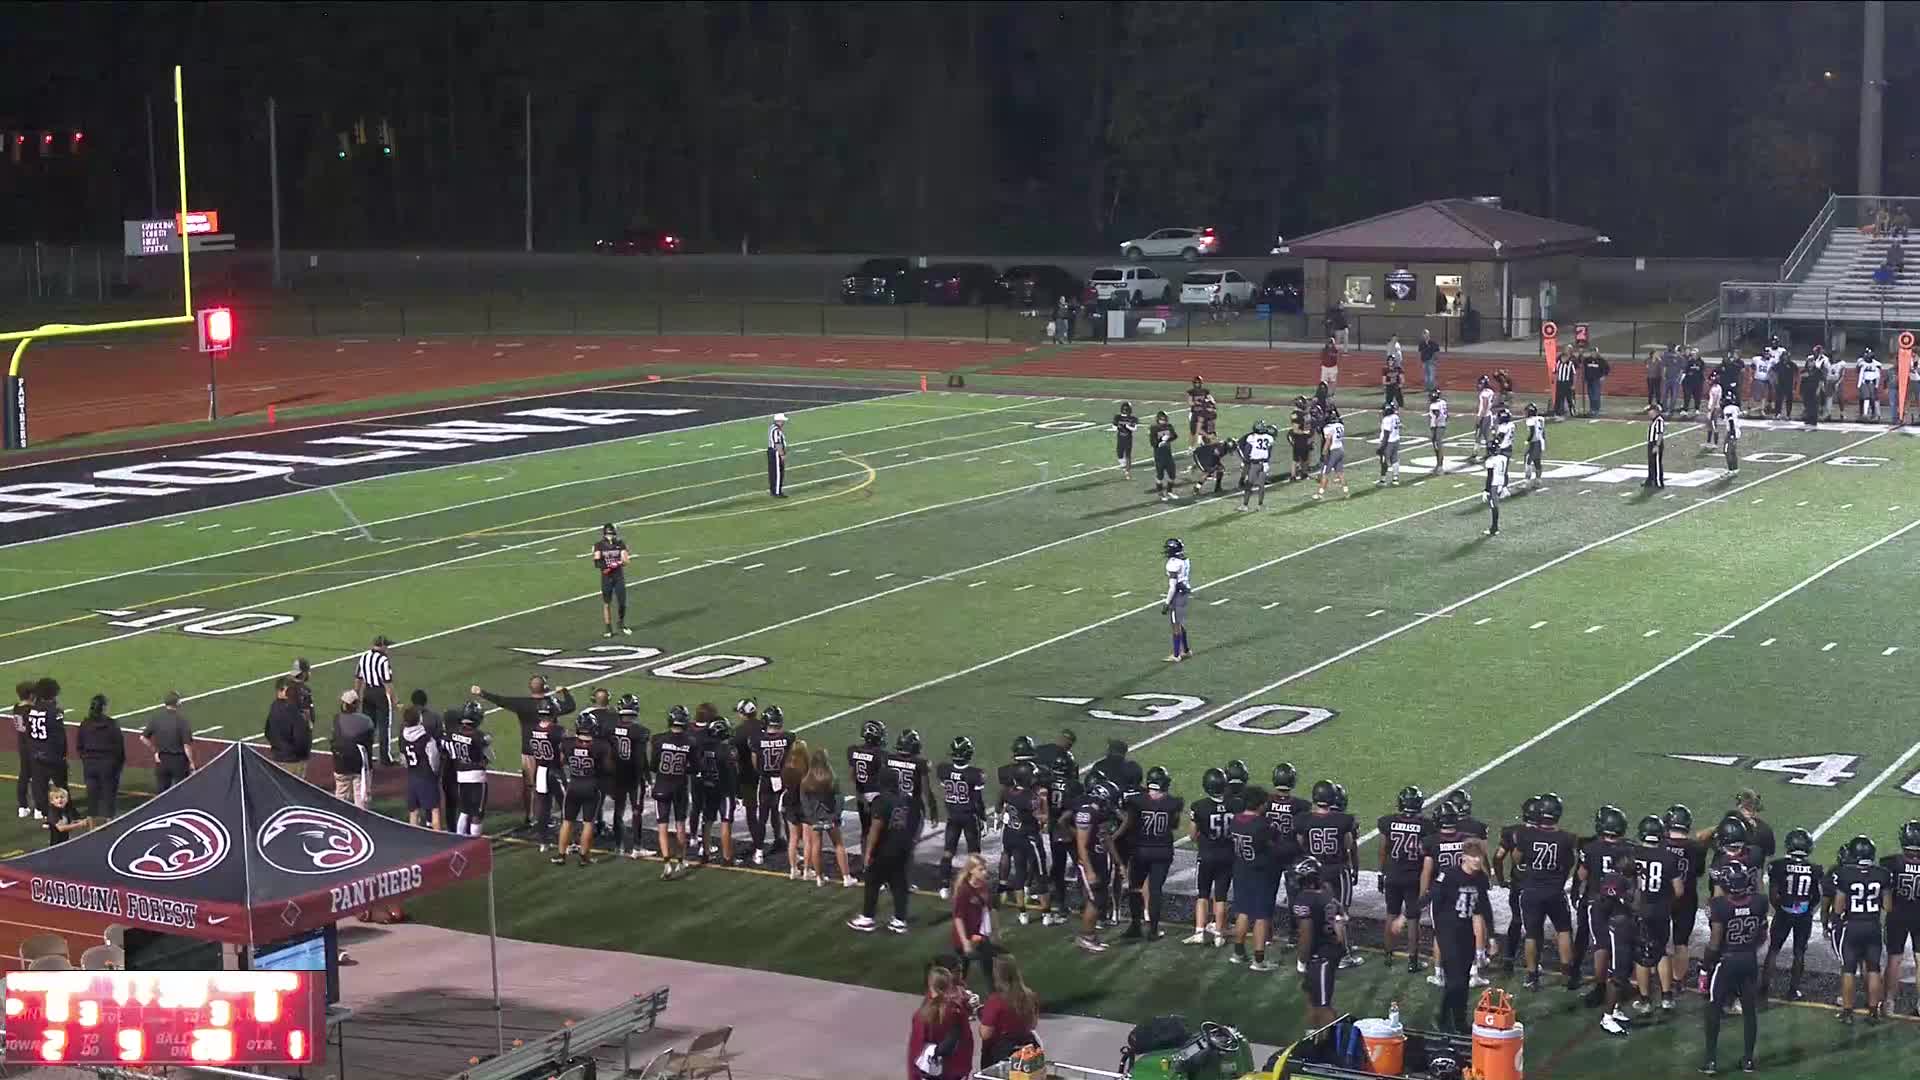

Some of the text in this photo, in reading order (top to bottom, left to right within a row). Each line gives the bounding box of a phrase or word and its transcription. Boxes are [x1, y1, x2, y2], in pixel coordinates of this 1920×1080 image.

[1256, 438, 1270, 451] 33
[107, 607, 295, 635] 10
[537, 645, 768, 679] 20
[1088, 693, 1334, 735] 30
[28, 716, 47, 740] 35
[405, 745, 418, 766] 5
[763, 747, 785, 771] 17
[1271, 803, 1292, 813] PEAKE
[1142, 810, 1169, 837] 70
[1391, 822, 1421, 833] CARRASCO
[1309, 828, 1339, 855] 65
[1390, 832, 1419, 861] 74
[1532, 841, 1558, 871] 71
[1786, 865, 1812, 875] GREENE
[330, 863, 422, 913] PANTHERS
[1786, 875, 1812, 896] 10
[1850, 882, 1881, 913] 22
[31, 877, 198, 928] CAROLINA FOREST
[1485, 1015, 1494, 1026] G
